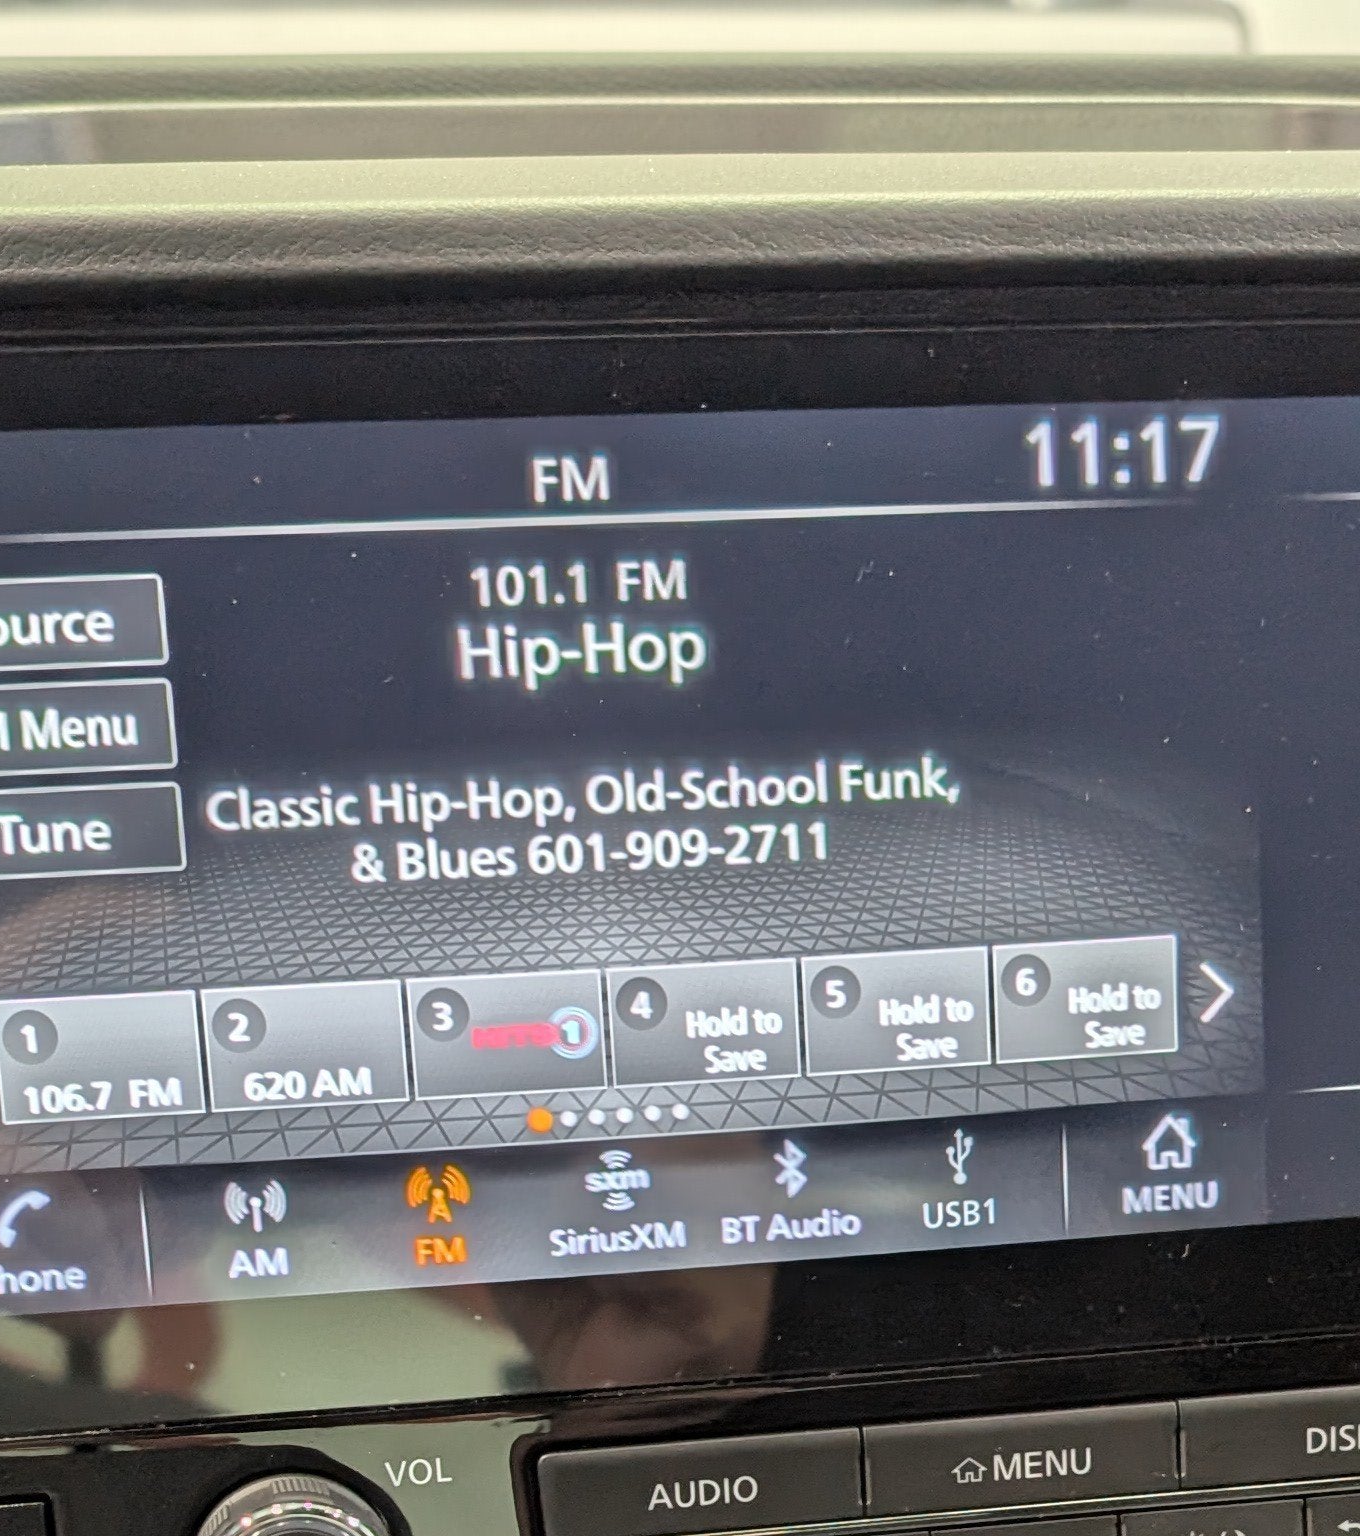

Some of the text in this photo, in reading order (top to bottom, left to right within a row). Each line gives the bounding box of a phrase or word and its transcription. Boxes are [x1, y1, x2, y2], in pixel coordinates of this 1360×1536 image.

[1027, 415, 1220, 488] 11:17
[532, 456, 609, 503] FM
[470, 560, 688, 608] 101.1 FM
[455, 622, 707, 691] Hip-Hop
[20, 709, 139, 750] Menu
[205, 753, 960, 832] Classic Hip-Hop, Old-School Funk,
[350, 822, 828, 884] & Blues 601-909-2711
[825, 980, 846, 1009] 5
[1015, 967, 1038, 995] 6
[630, 990, 652, 1019] 4
[878, 994, 973, 1026] Hold to
[1067, 983, 1161, 1015] Hold to
[227, 1013, 249, 1043] 2
[432, 1001, 455, 1031] 3
[685, 1006, 782, 1040] Hold to
[20, 1024, 37, 1054] 1
[895, 1032, 958, 1062] Save
[1085, 1020, 1146, 1048] Save
[703, 1045, 767, 1075] Save
[22, 1079, 183, 1115] 106.7 FM
[243, 1066, 373, 1102] 620 AM
[585, 1166, 651, 1191] sxm
[1122, 1180, 1219, 1214] MENU
[721, 1209, 861, 1244] BT Audio
[922, 1198, 997, 1230] USB1
[414, 1237, 468, 1266] FM
[549, 1221, 687, 1257] SiriusXM
[229, 1248, 290, 1279] AM
[385, 1458, 453, 1487] VOL
[992, 1447, 1092, 1481] MENU
[648, 1475, 758, 1511] AUDIO
